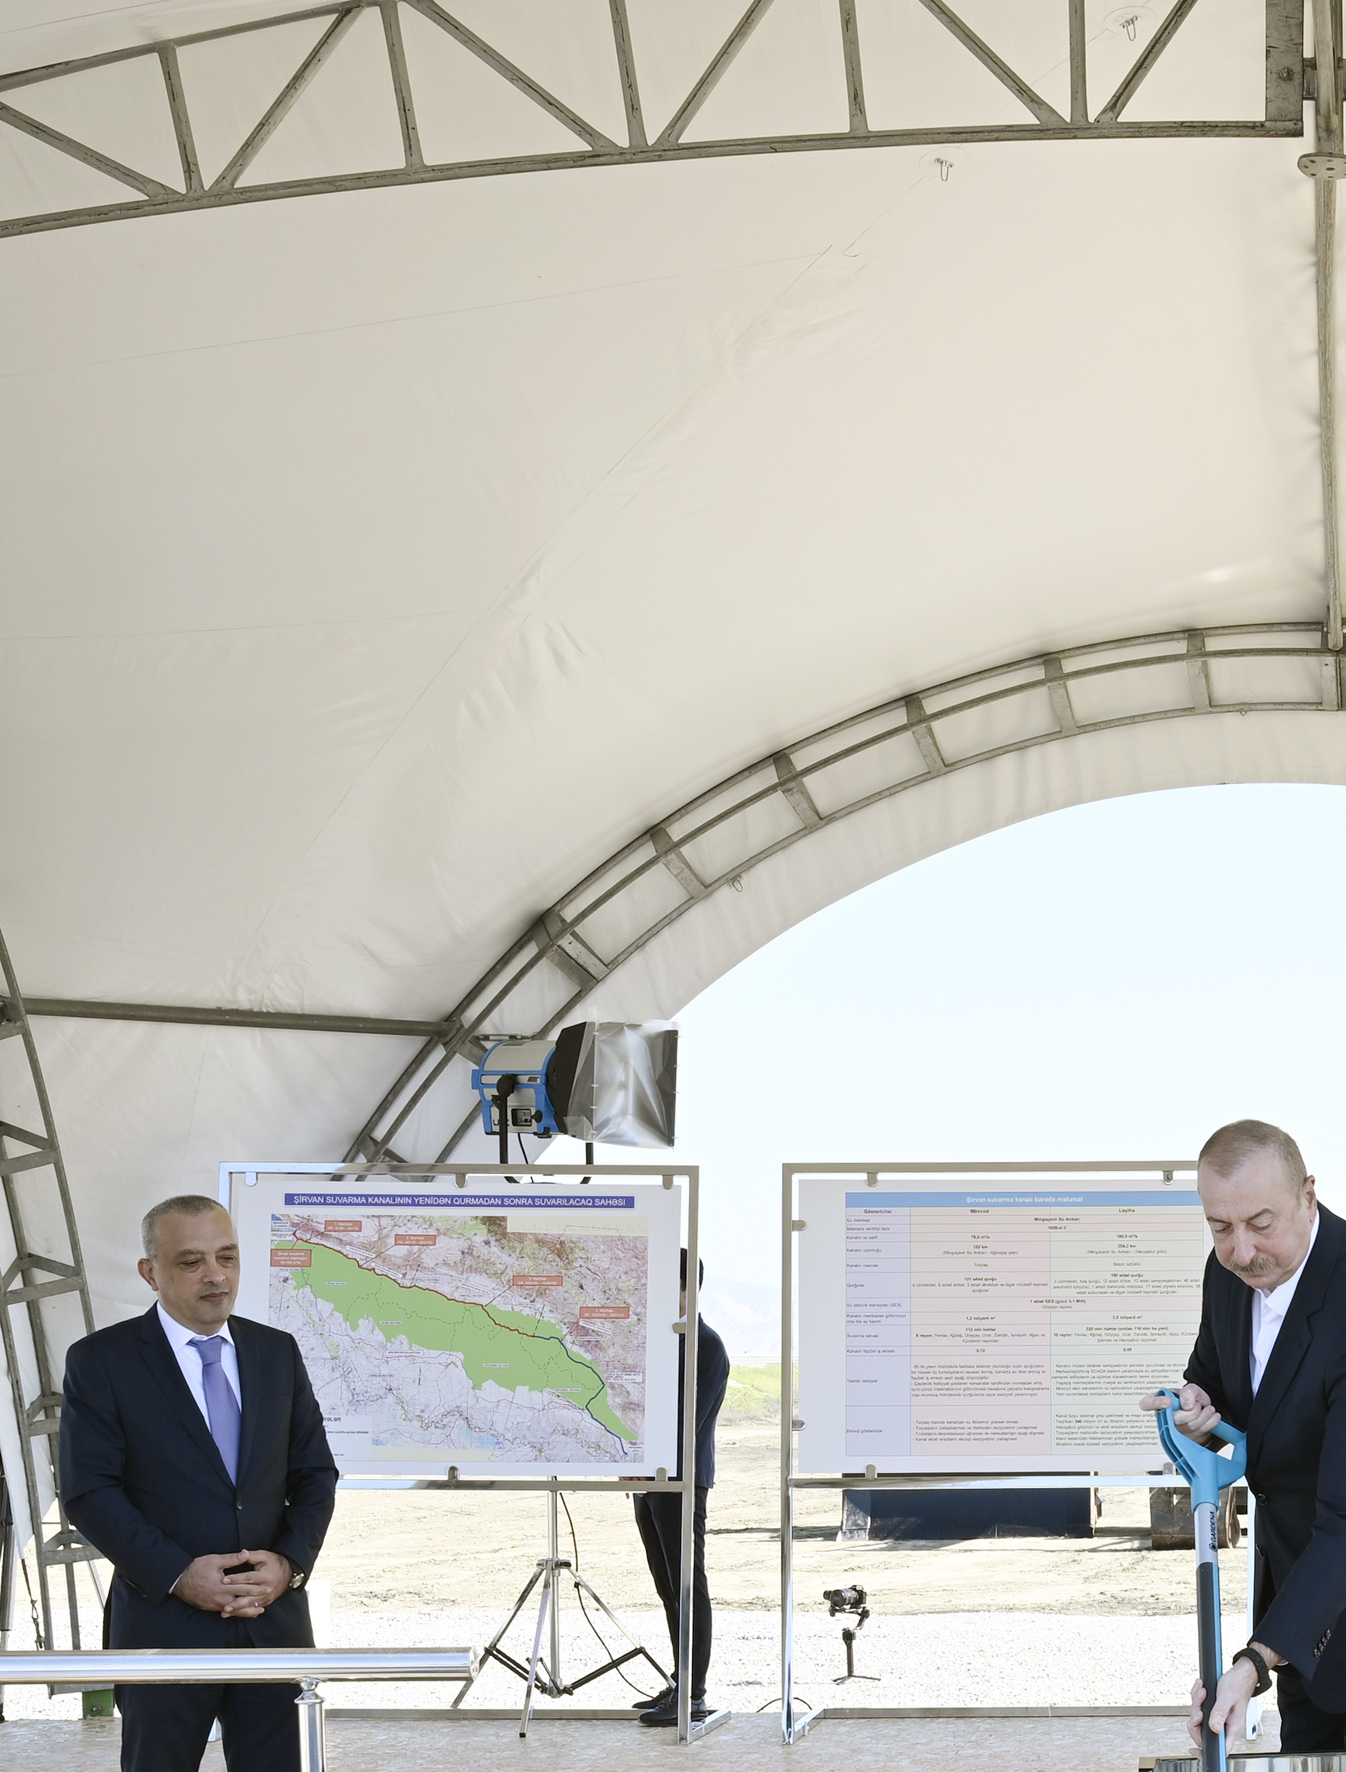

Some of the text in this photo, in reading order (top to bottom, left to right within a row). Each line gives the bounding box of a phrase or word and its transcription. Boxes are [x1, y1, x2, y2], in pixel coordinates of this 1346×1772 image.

[293, 1194, 626, 1206] ŞİRVAN SUVARMA KANALININ YENİDƏN QURMADAN SONRA SUVARILACAQ SAHƏSİ
[966, 1196, 986, 1204] Şirvan
